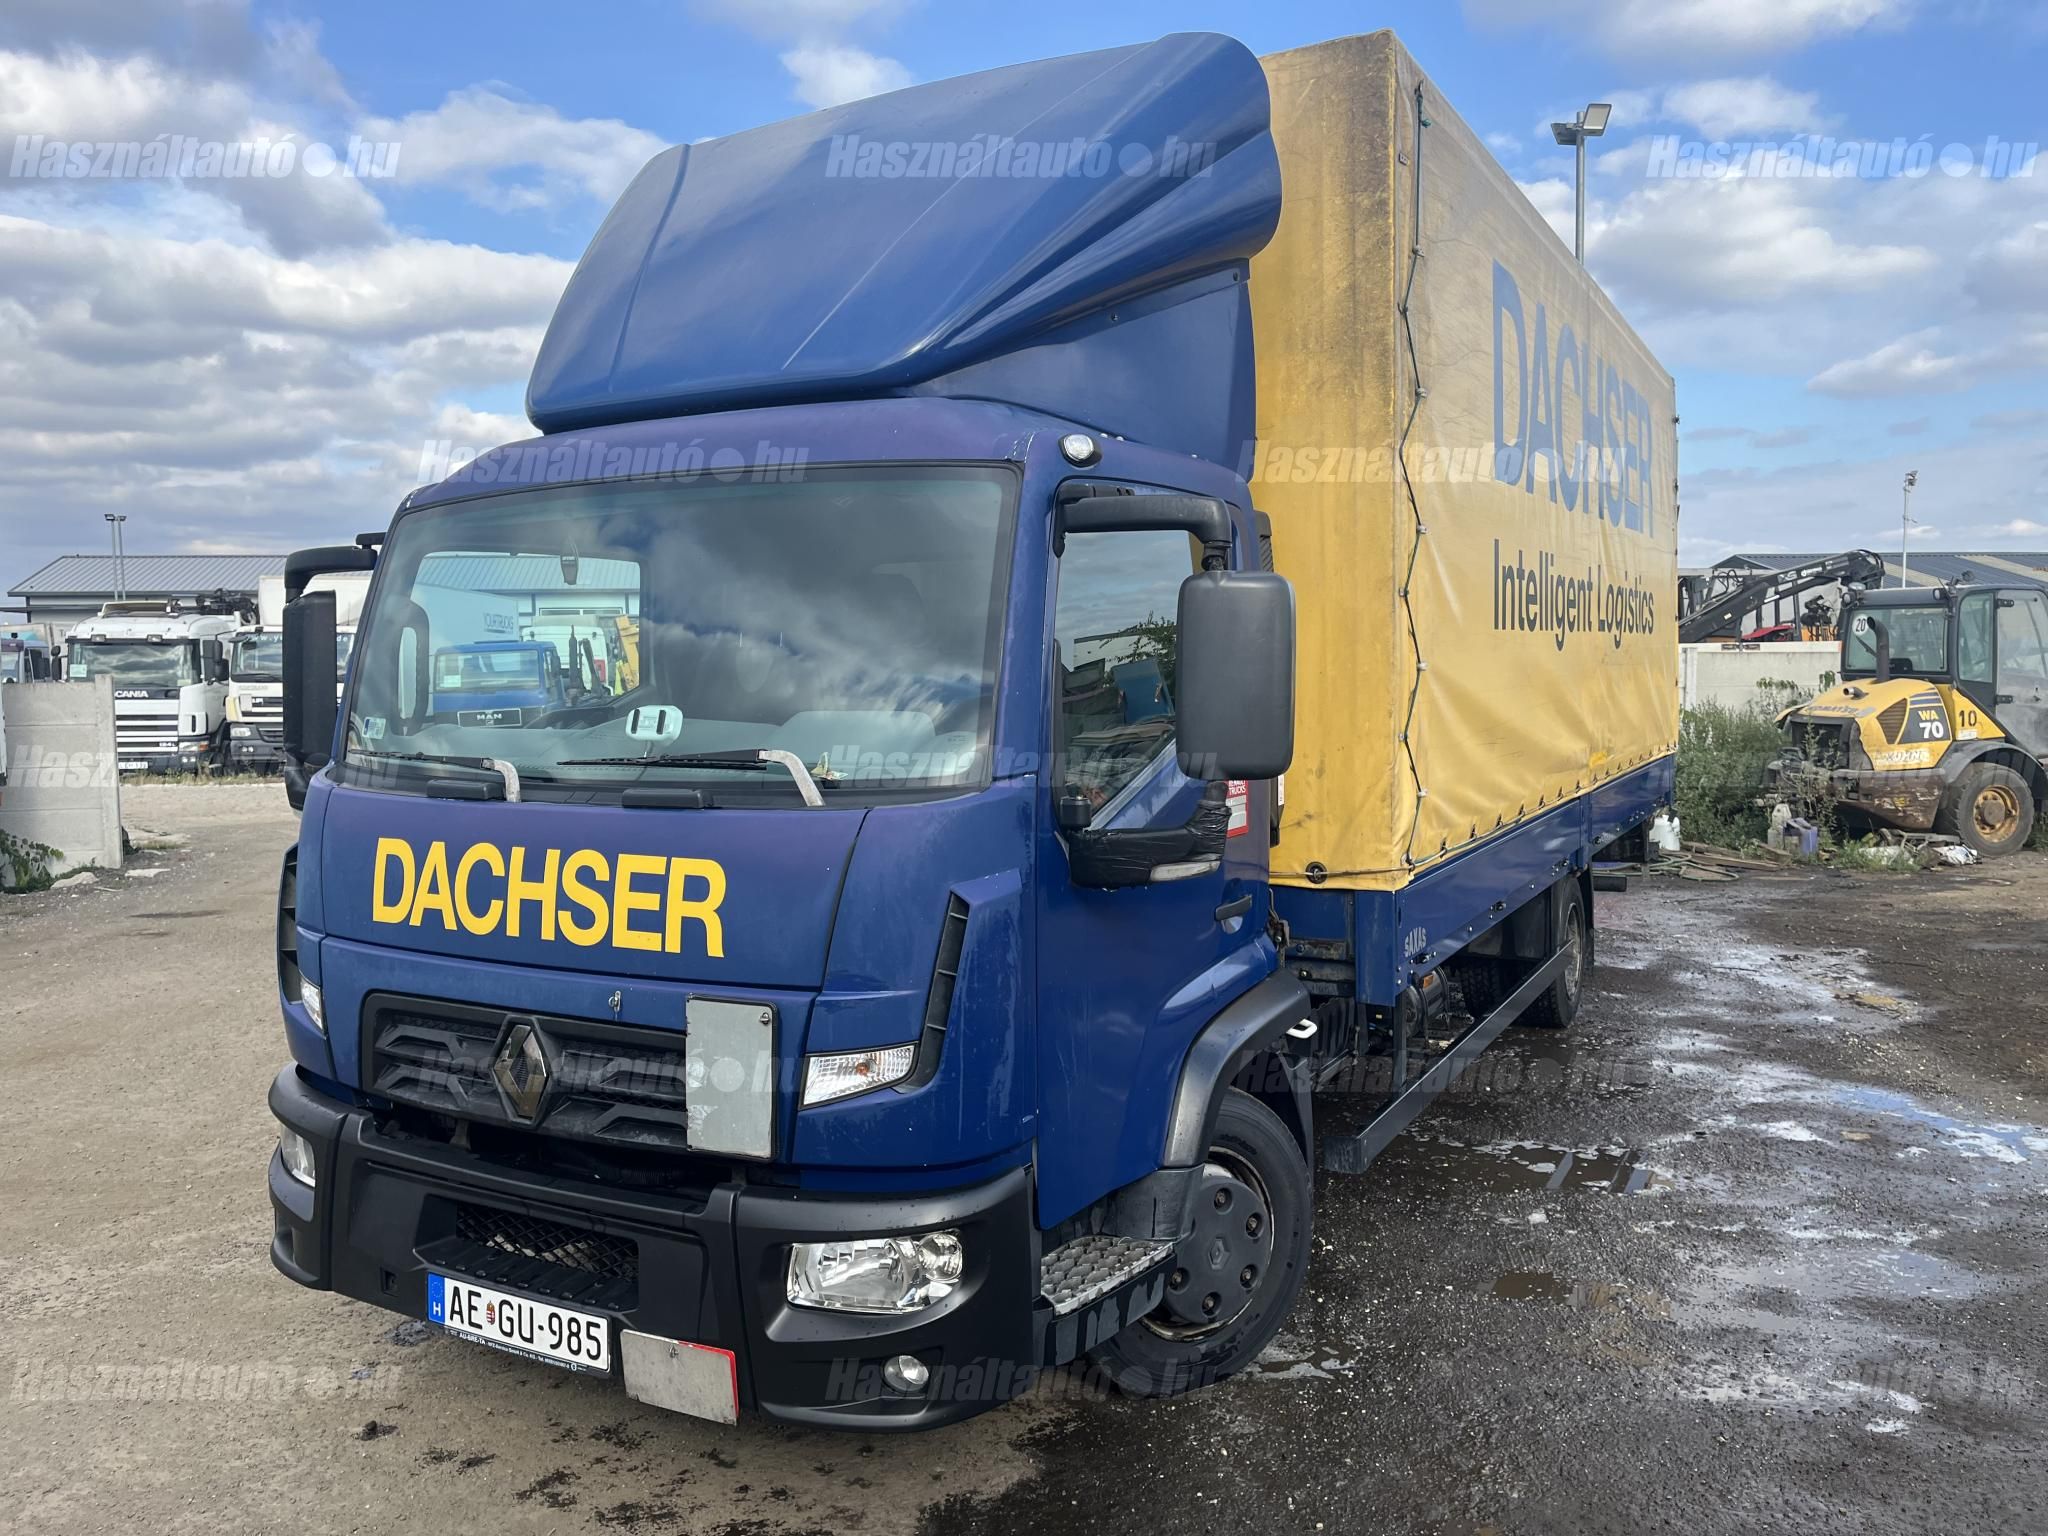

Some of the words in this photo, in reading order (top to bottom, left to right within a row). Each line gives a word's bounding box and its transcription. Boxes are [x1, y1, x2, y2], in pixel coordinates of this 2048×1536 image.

[1493, 259, 1654, 538] DACHSER
[1493, 539, 1592, 651] Intelligent
[1597, 564, 1654, 649] Logistics
[1855, 618, 1867, 632] 20
[114, 690, 149, 698] CANIA
[476, 713, 503, 721] MAN
[1918, 710, 1939, 721] WA
[1959, 710, 1977, 727] 10
[1919, 721, 1944, 739] 70
[372, 837, 726, 958] DACHSER
[1404, 926, 1427, 958] SAXAS
[432, 1302, 441, 1317] H
[449, 1285, 483, 1331] AE
[498, 1298, 602, 1361] GU-985
